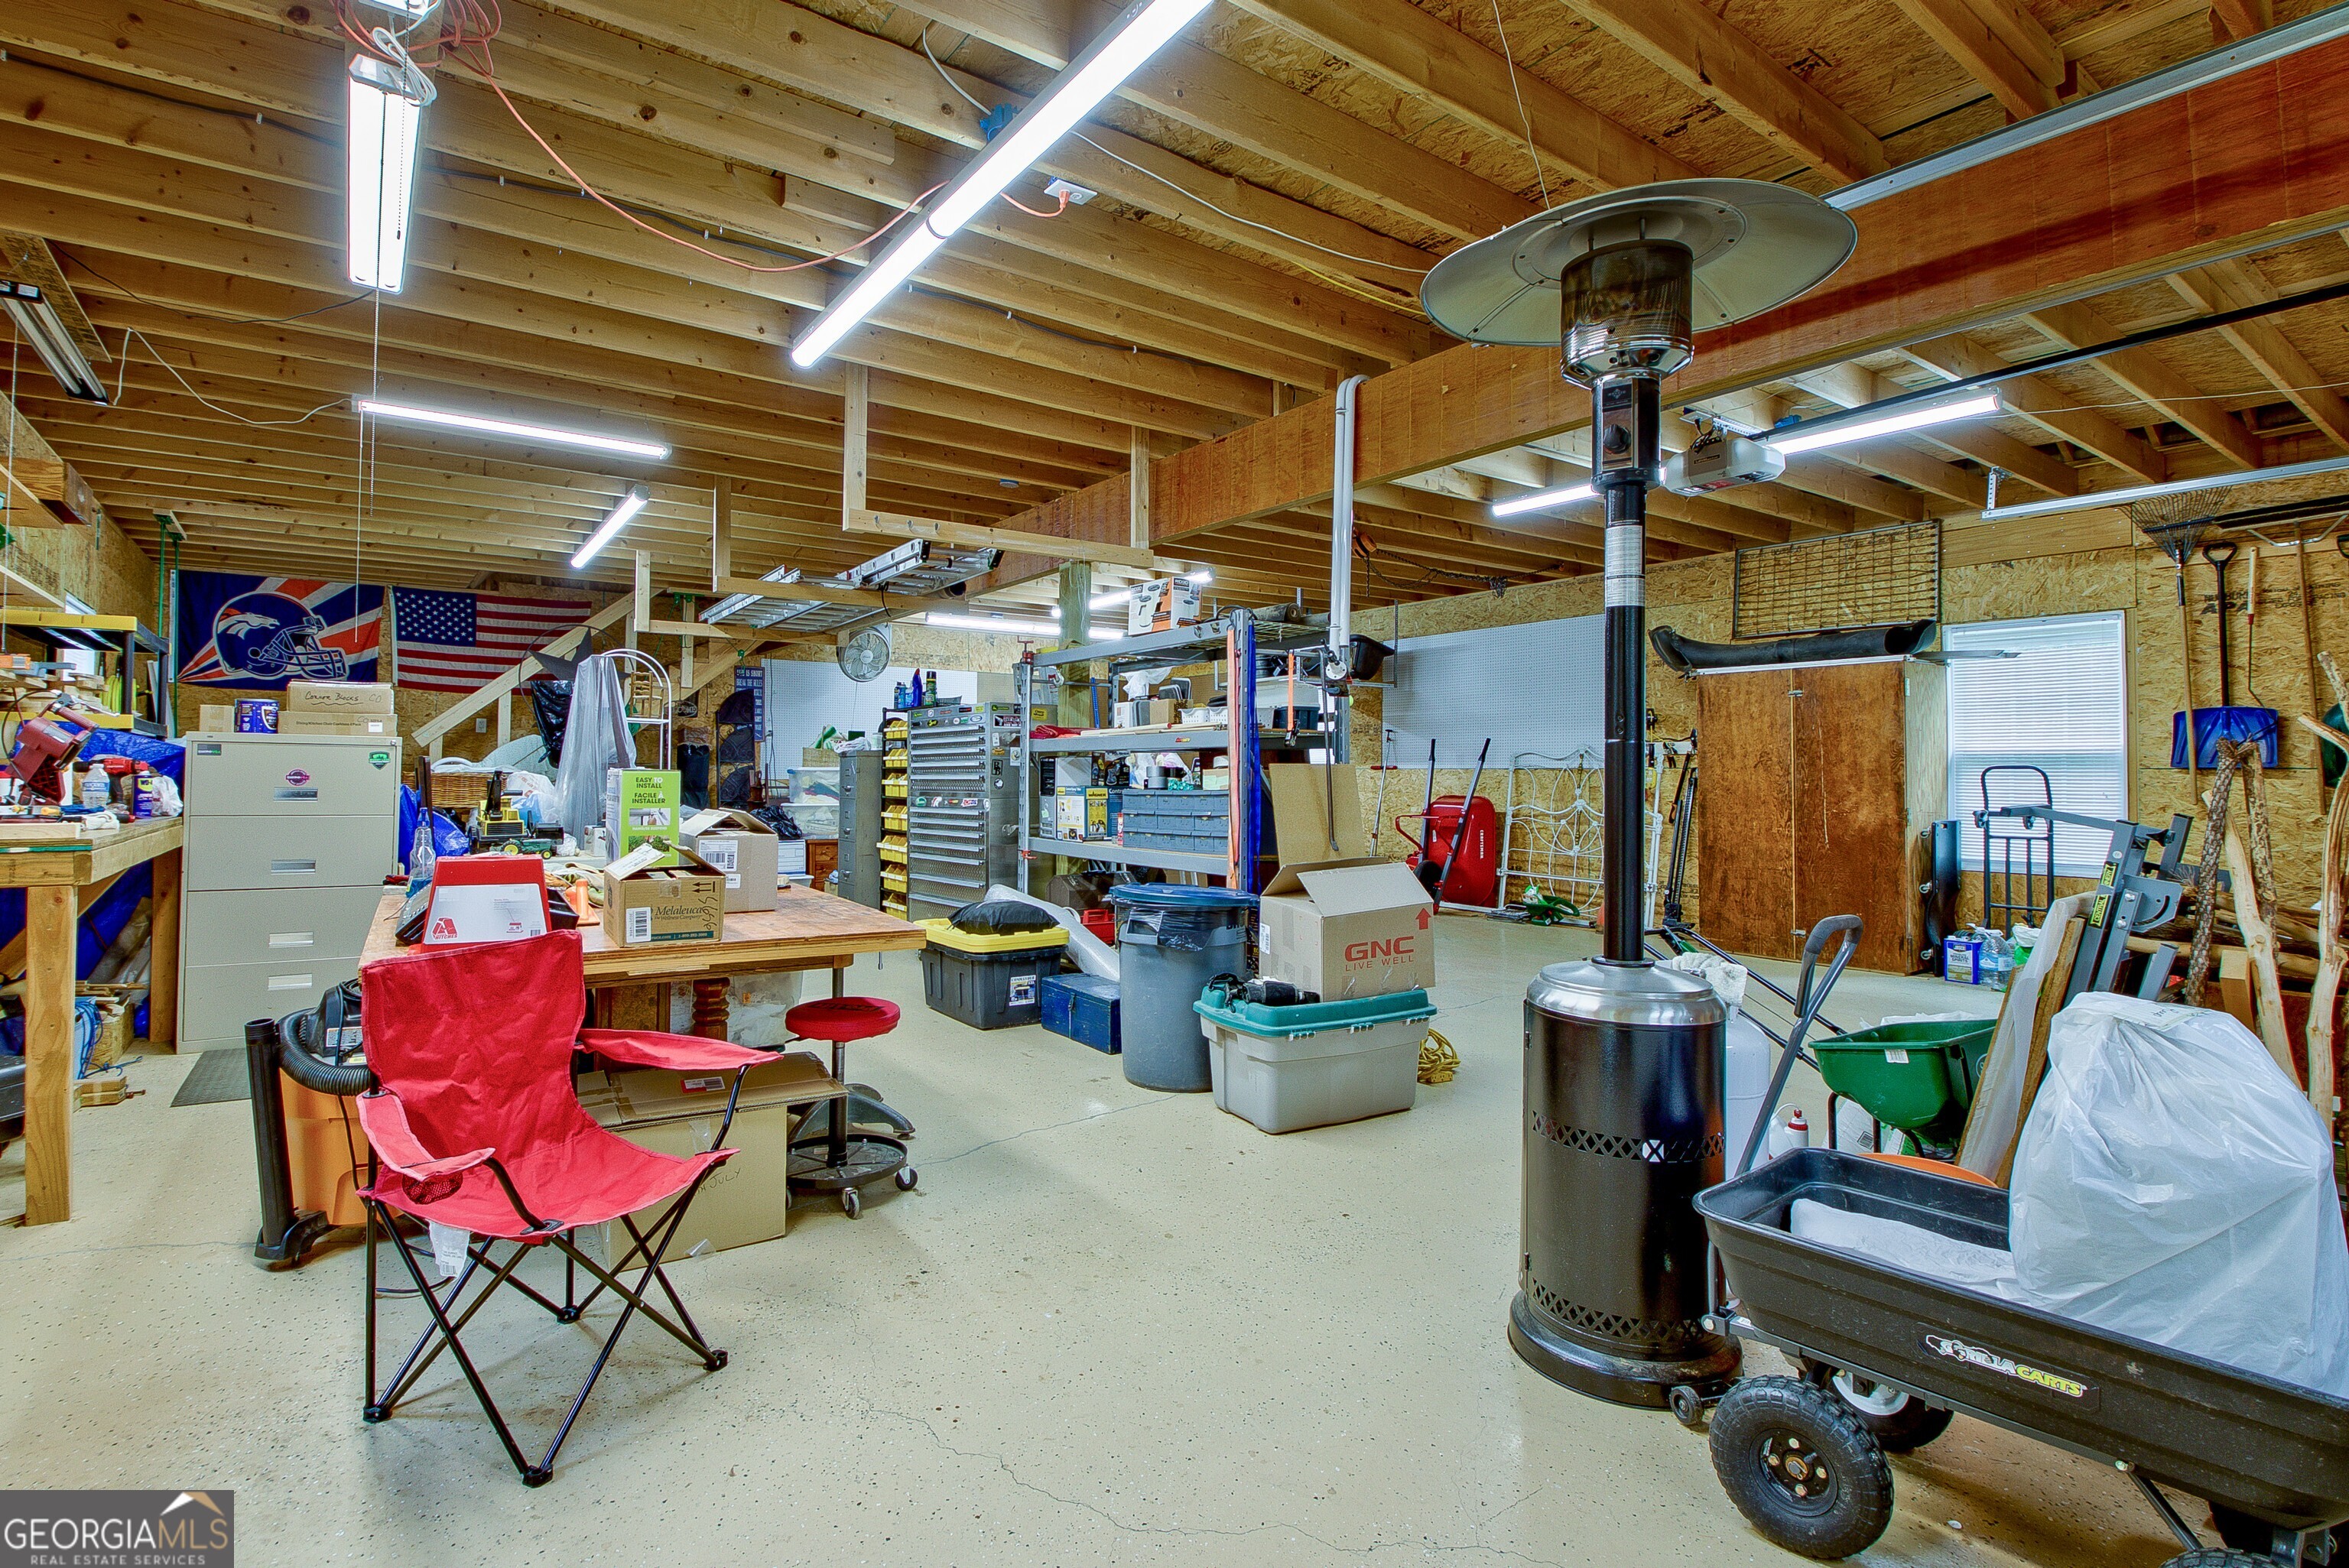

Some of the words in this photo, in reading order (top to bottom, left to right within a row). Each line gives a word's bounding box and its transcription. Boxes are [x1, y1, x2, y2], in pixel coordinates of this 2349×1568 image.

[655, 904, 702, 916] Melaleuca
[2094, 897, 2107, 922] CENTRAL
[1345, 936, 1415, 962] GNC
[1345, 960, 1373, 972] LIVE
[1381, 955, 1415, 966] WELL
[709, 1167, 741, 1189] JULY
[2016, 1365, 2081, 1396] CARTS
